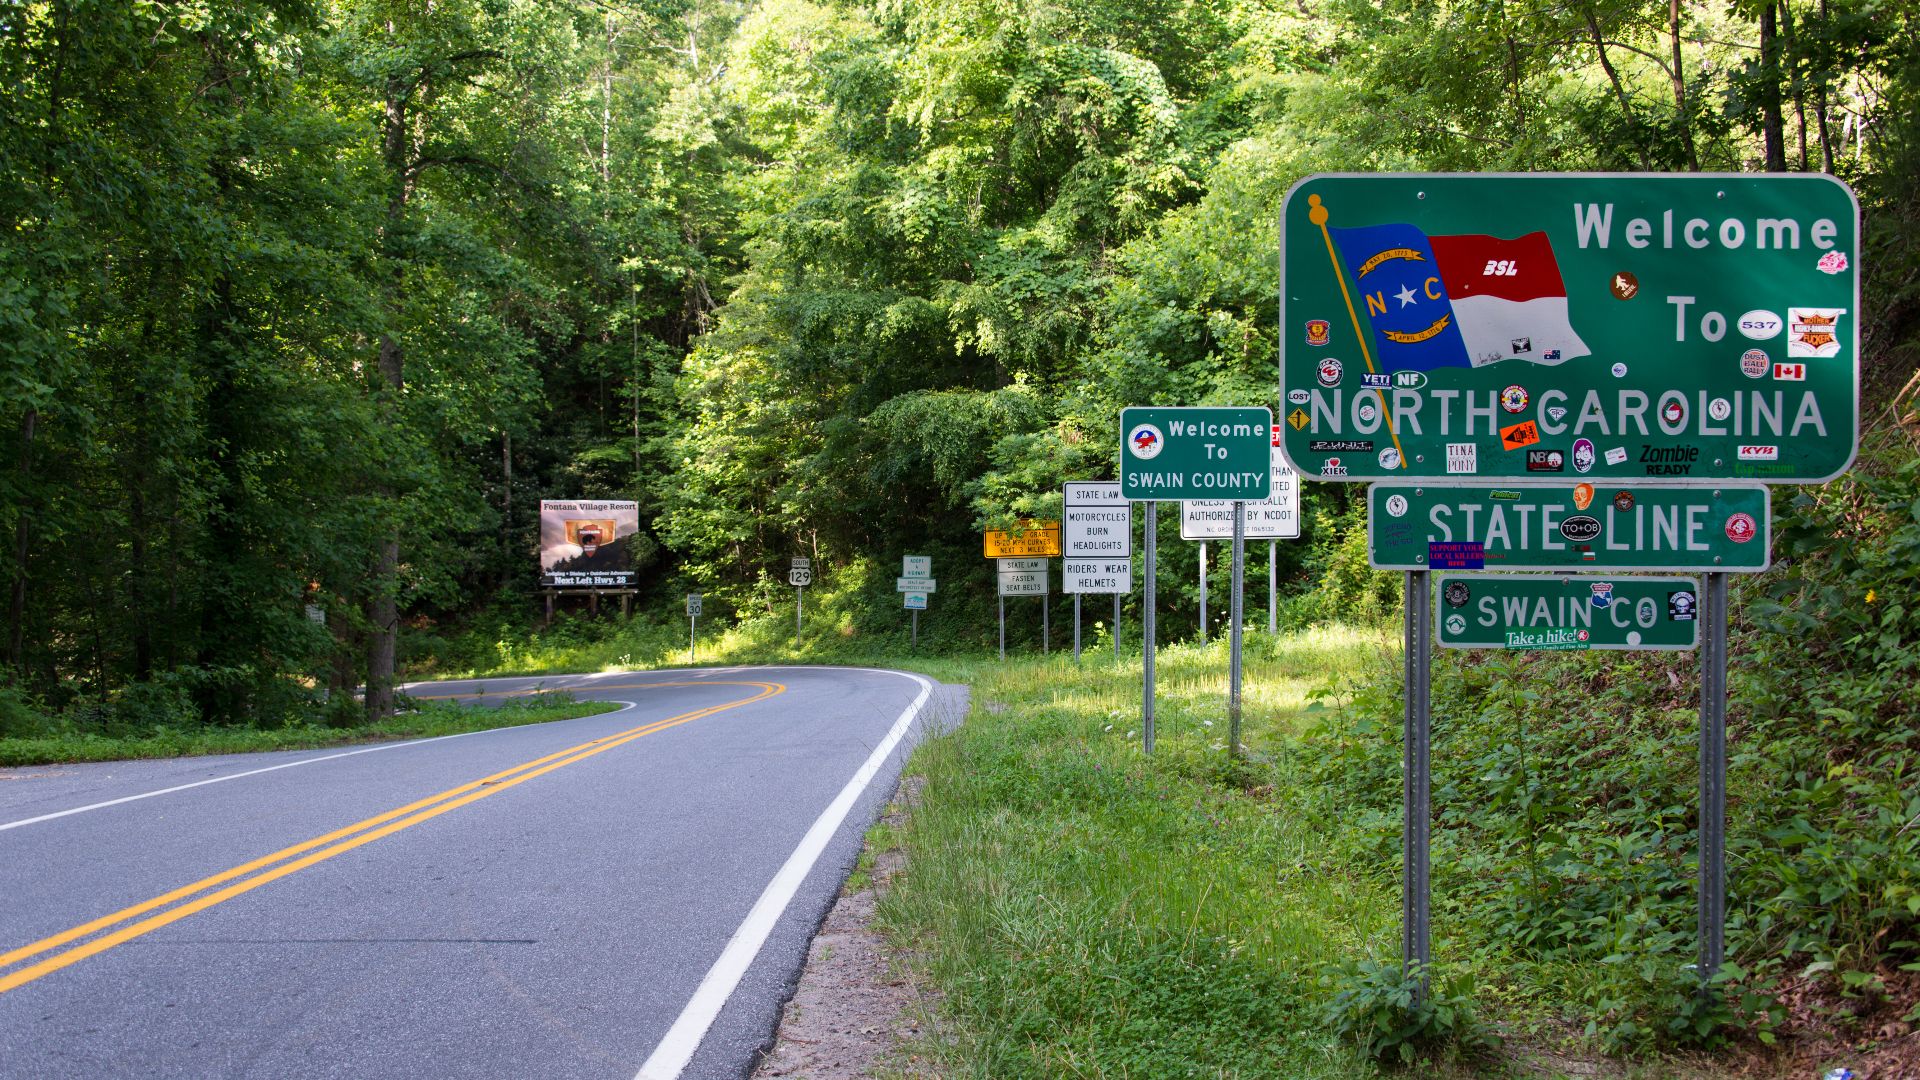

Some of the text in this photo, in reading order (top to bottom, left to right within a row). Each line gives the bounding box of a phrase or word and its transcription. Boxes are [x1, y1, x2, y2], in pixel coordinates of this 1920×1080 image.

[1574, 203, 1837, 249] Welcome
[1483, 260, 1518, 276] BSL
[1366, 277, 1441, 317] N C
[1667, 296, 1727, 342] To
[1804, 334, 1830, 345] FUCKER
[1362, 374, 1391, 383] YETI
[1397, 374, 1419, 385] NF
[1310, 389, 1827, 437] NORTH CAROLINA
[1169, 421, 1264, 437] Welcome
[1204, 444, 1228, 459] To
[1448, 445, 1473, 456] TINA
[1639, 444, 1699, 463] Zombie
[1448, 460, 1475, 472] PONY
[1646, 465, 1691, 475] READY
[1128, 473, 1264, 488] SWAIN COUNTY
[1076, 491, 1118, 499] STATE LAW
[1069, 513, 1126, 521] MOTORCYCLES
[1190, 510, 1292, 520] AUTHORIZE BY NCDOT
[1087, 527, 1109, 536] BURN
[1427, 504, 1565, 550] STATE
[1606, 505, 1709, 551] LINE
[1073, 542, 1122, 550] HEADLIGHTS
[1068, 565, 1127, 574] RIDERS WEAR
[576, 576, 592, 584] Left
[594, 577, 615, 585] Hwy.
[792, 572, 809, 582] 129
[1079, 579, 1116, 588] HELMETS
[690, 606, 700, 614] 30
[1477, 596, 1657, 628] SWAIN CO
[1506, 632, 1534, 645] Take
[1546, 629, 1577, 642] hike!
